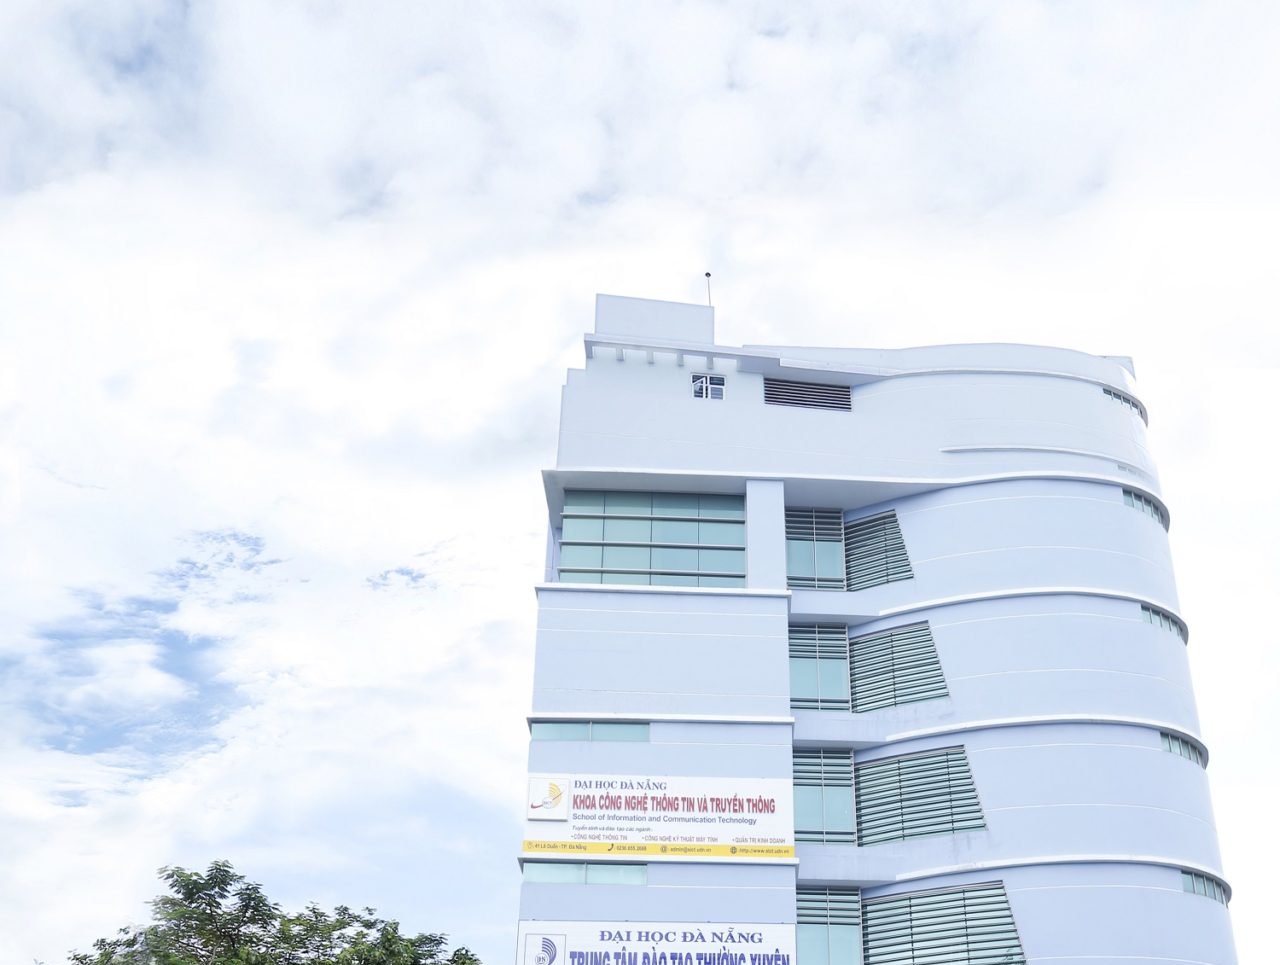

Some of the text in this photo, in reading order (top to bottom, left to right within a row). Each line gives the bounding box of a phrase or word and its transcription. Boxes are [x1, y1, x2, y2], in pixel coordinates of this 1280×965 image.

[574, 778, 667, 791] ĐẠI HỌC ĐÀ NẴNG
[572, 791, 776, 814] KHOA CÔNG NGHỆ THÔNG TIN VÀ TRUYỀN THÔNG
[572, 813, 757, 826] School of Information and Communication Technology
[599, 927, 763, 945] ĐẠI HỌC ĐÀ NẴNG
